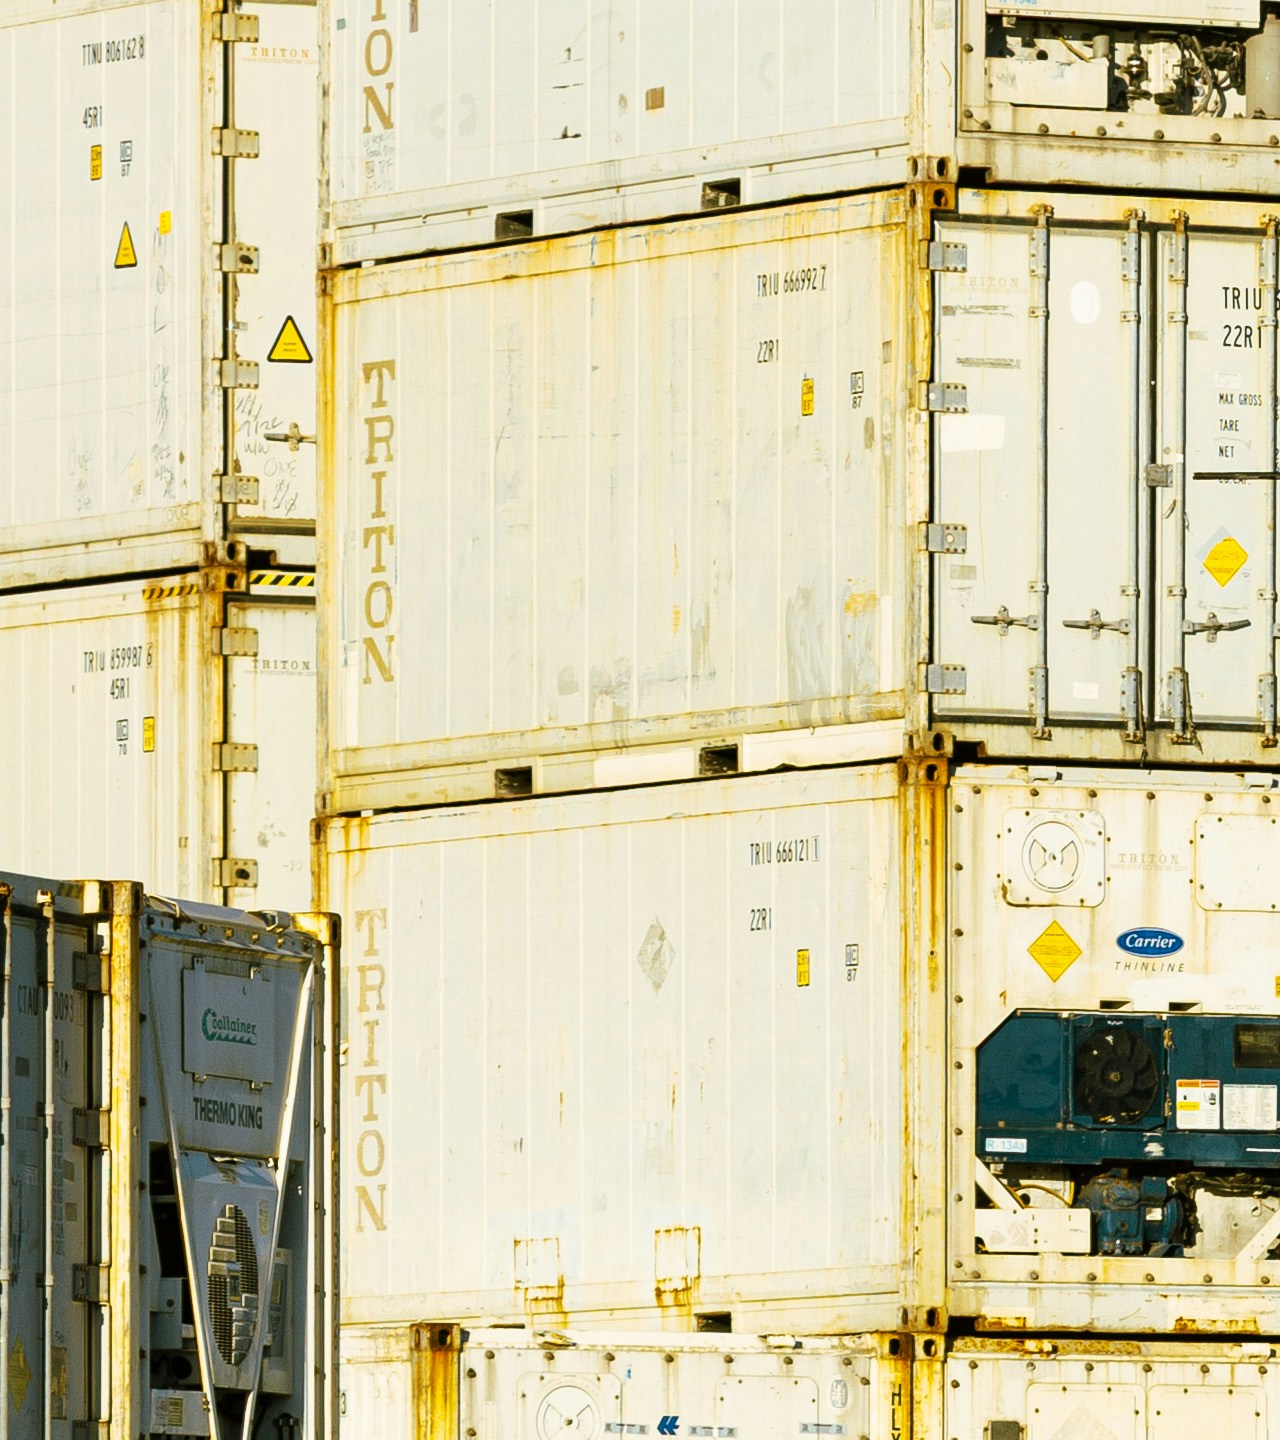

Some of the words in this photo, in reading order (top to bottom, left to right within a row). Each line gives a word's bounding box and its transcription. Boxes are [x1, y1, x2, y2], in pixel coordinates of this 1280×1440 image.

[83, 43, 102, 66] TTNU
[250, 47, 310, 58] TRITON
[83, 106, 102, 128] 45R1
[757, 273, 779, 297] TRIU
[783, 266, 818, 294] 666992
[1222, 287, 1262, 310] TRIU
[1223, 325, 1264, 349] 22R1
[757, 339, 779, 364] 22R1
[1218, 393, 1237, 406] MAX
[1239, 394, 1262, 407] GROSS
[1219, 419, 1240, 432] TARE
[1218, 446, 1235, 458] NET
[362, 360, 396, 684] TRITON
[84, 651, 105, 673] TRIU
[110, 645, 142, 670] 859987
[251, 659, 312, 671] TRITON
[109, 678, 131, 700] 45R1
[750, 841, 772, 866] TRIU
[776, 838, 810, 864] 666121
[1118, 852, 1181, 864] TRITON
[750, 907, 772, 932] 22R1
[1125, 933, 1176, 950] Carrier
[1114, 961, 1186, 973] THINLINE
[354, 908, 388, 1233] TRITON
[193, 1096, 237, 1125] THERMO
[237, 1099, 263, 1130] KING
